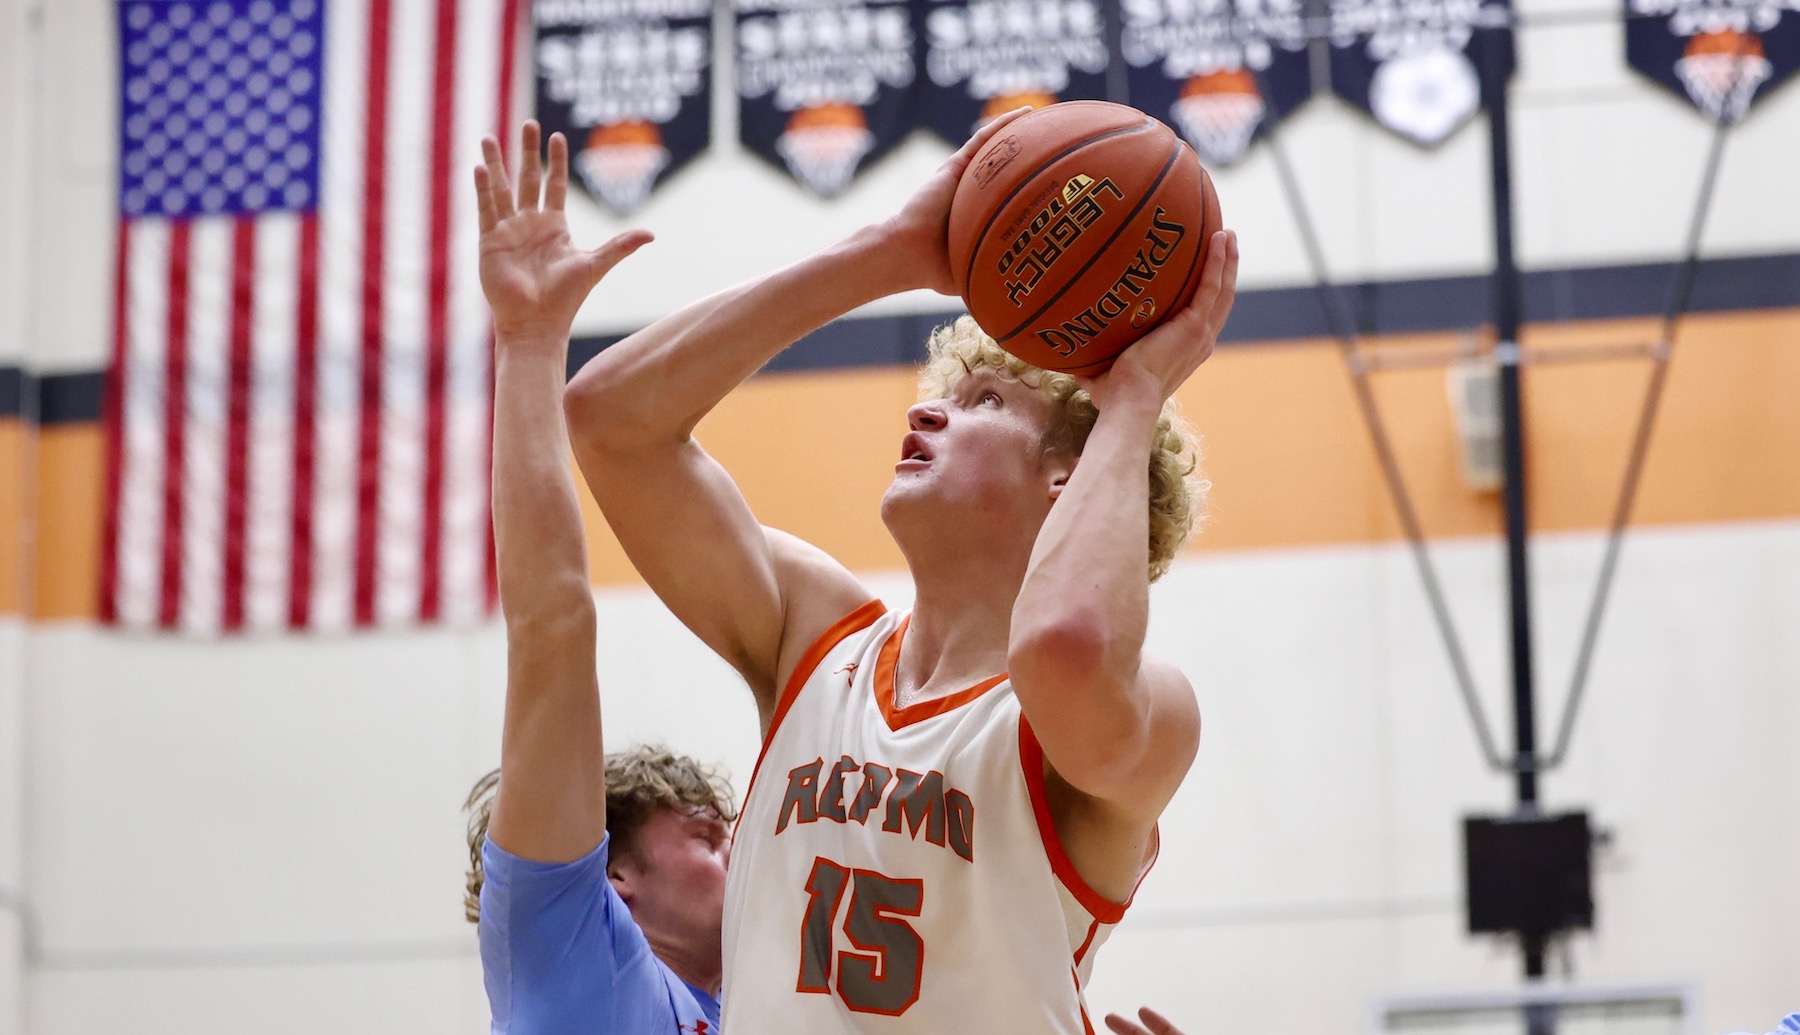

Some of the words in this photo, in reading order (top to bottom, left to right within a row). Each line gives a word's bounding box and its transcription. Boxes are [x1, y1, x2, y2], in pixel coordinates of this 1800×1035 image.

[997, 197, 1064, 275] 1000
[1004, 176, 1125, 308] LEGACY
[1036, 206, 1185, 357] SPALDING
[796, 856, 924, 1017] 15
